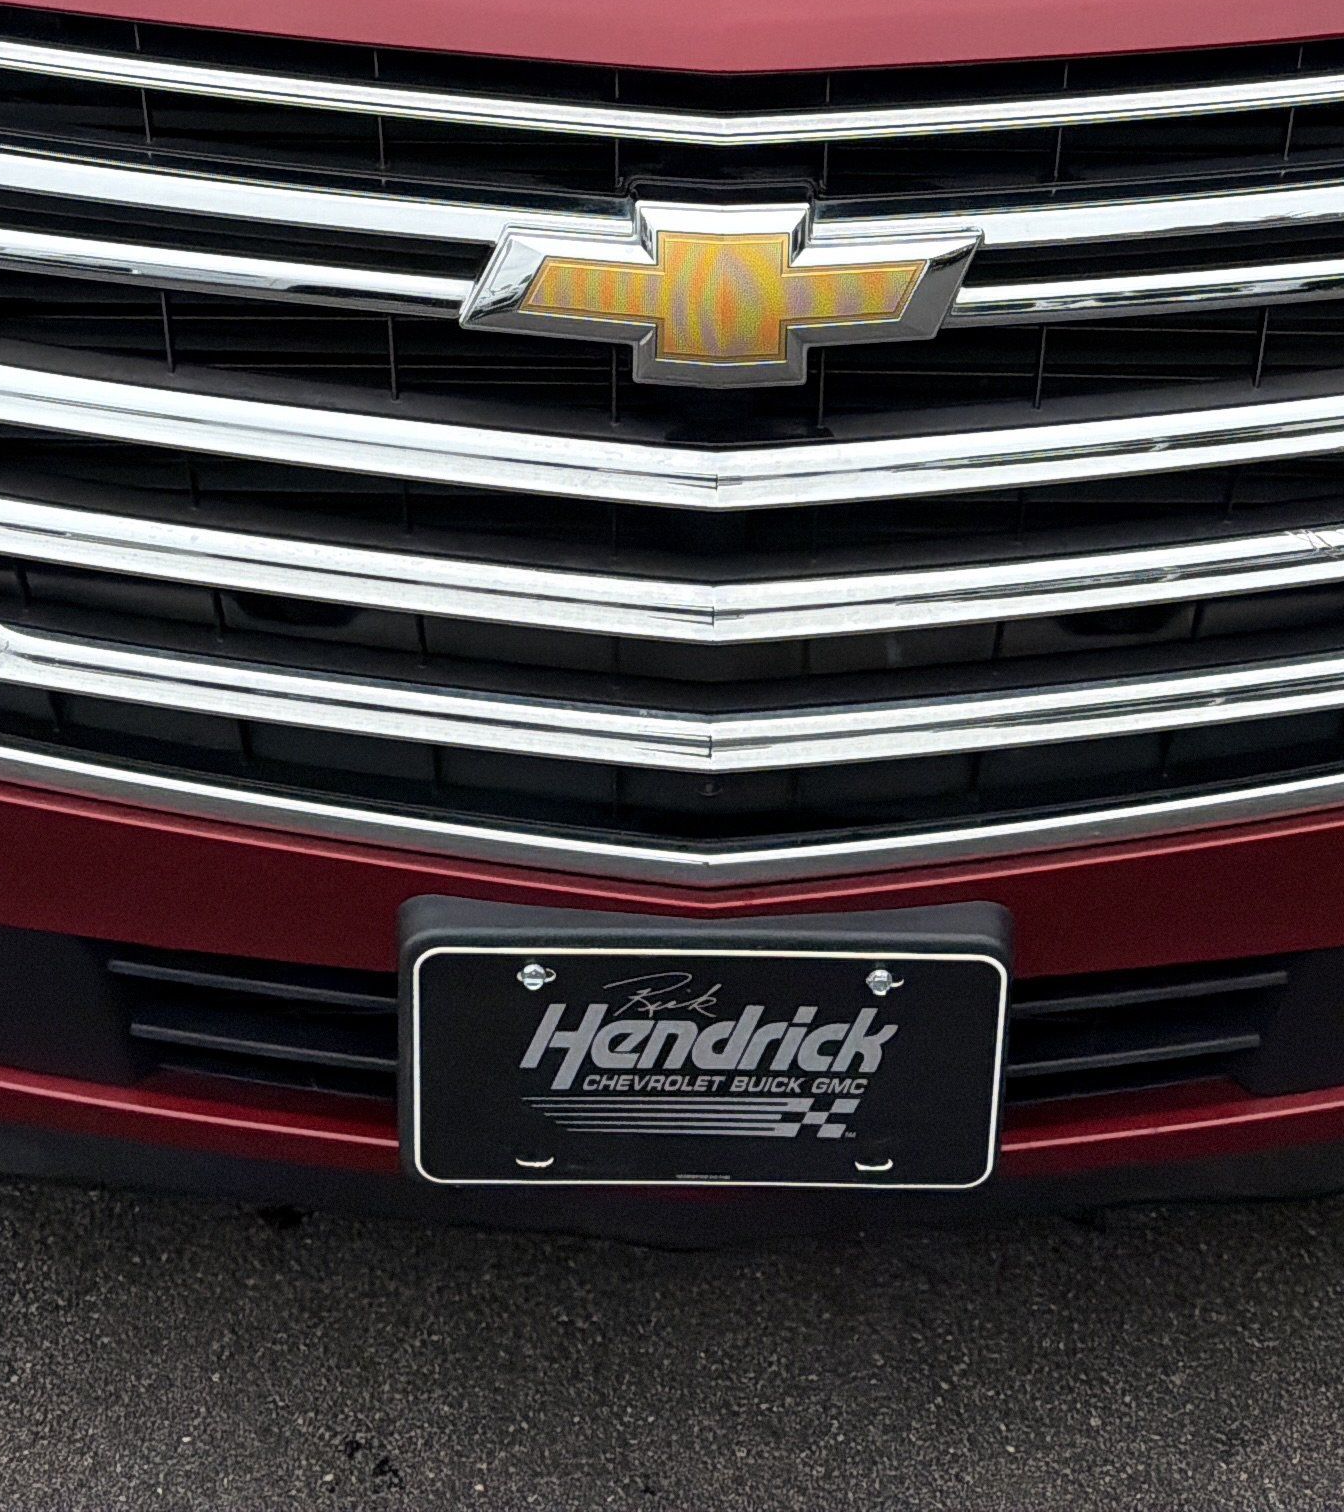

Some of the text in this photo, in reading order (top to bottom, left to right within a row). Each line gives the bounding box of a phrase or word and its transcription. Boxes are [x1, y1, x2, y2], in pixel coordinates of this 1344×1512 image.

[518, 1003, 900, 1091] Hendrick
[582, 1074, 869, 1096] CHEVROLET BUICK GMC
